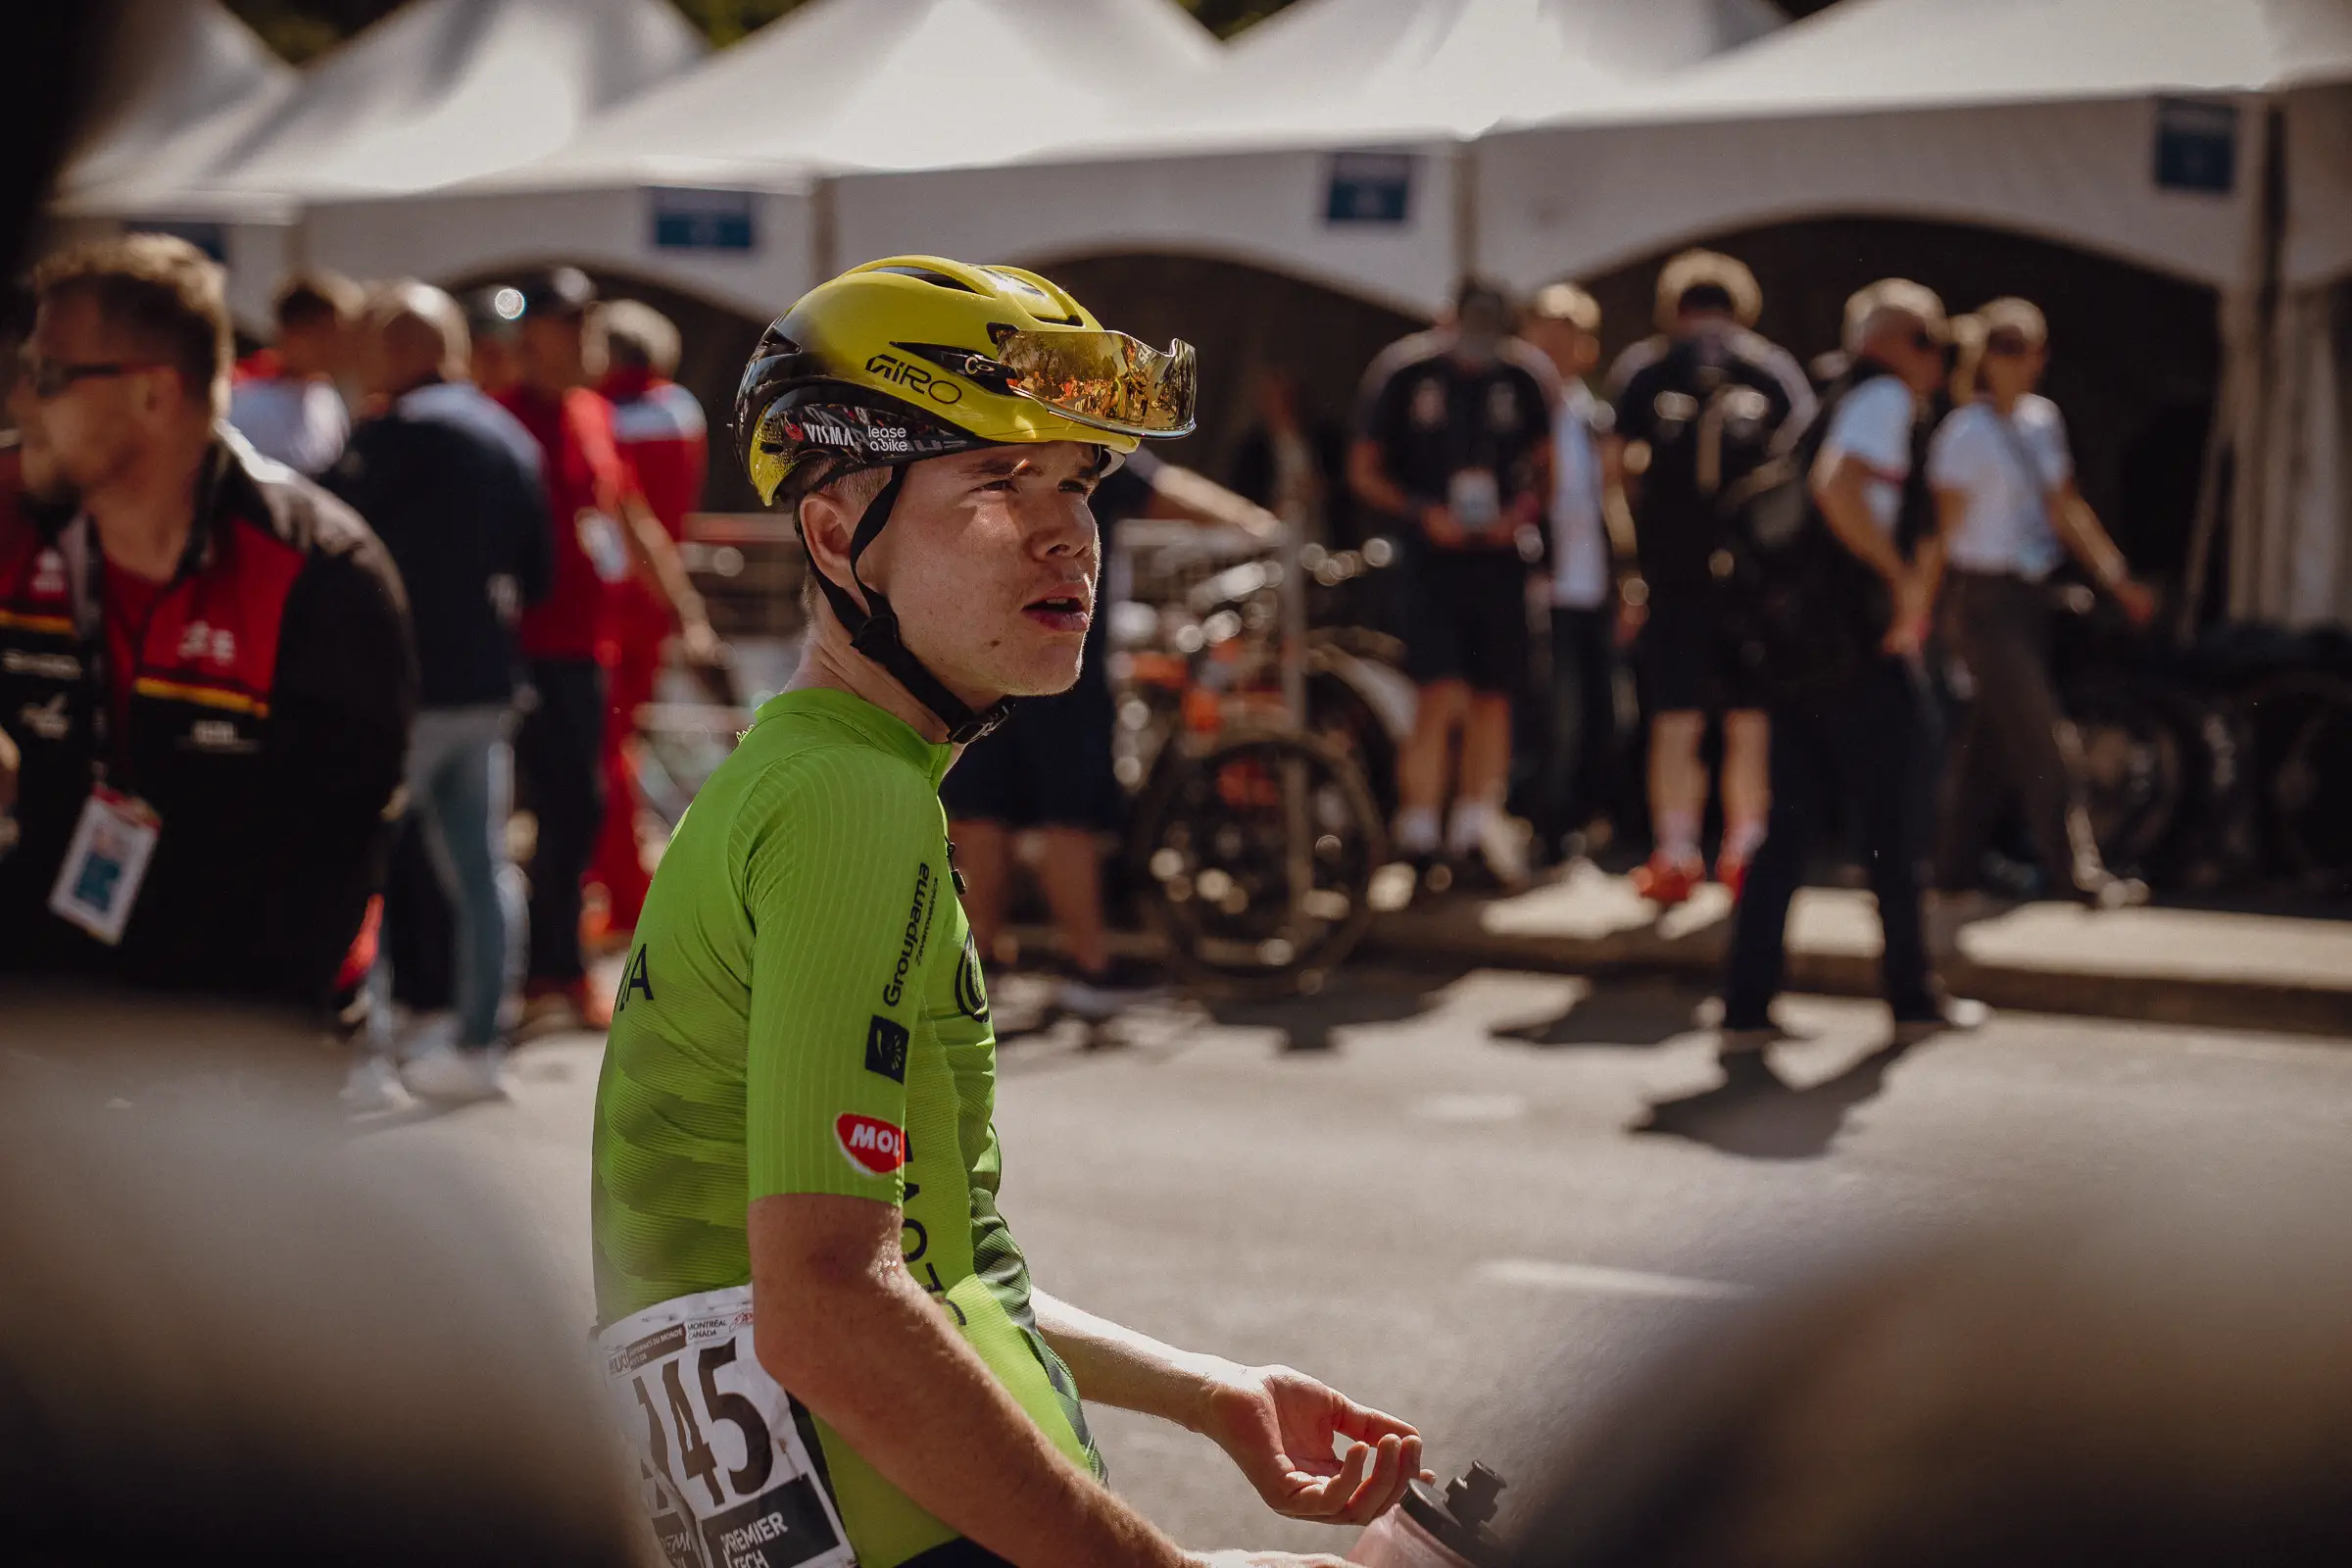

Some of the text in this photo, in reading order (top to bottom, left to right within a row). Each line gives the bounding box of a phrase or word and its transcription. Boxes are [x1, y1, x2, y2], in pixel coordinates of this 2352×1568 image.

[865, 354, 962, 405] GIRO
[803, 422, 854, 447] VISMA
[868, 424, 906, 438] lease
[883, 861, 930, 1007] Groupama
[688, 1329, 717, 1341] CANADA
[719, 1511, 789, 1555] PREMIER
